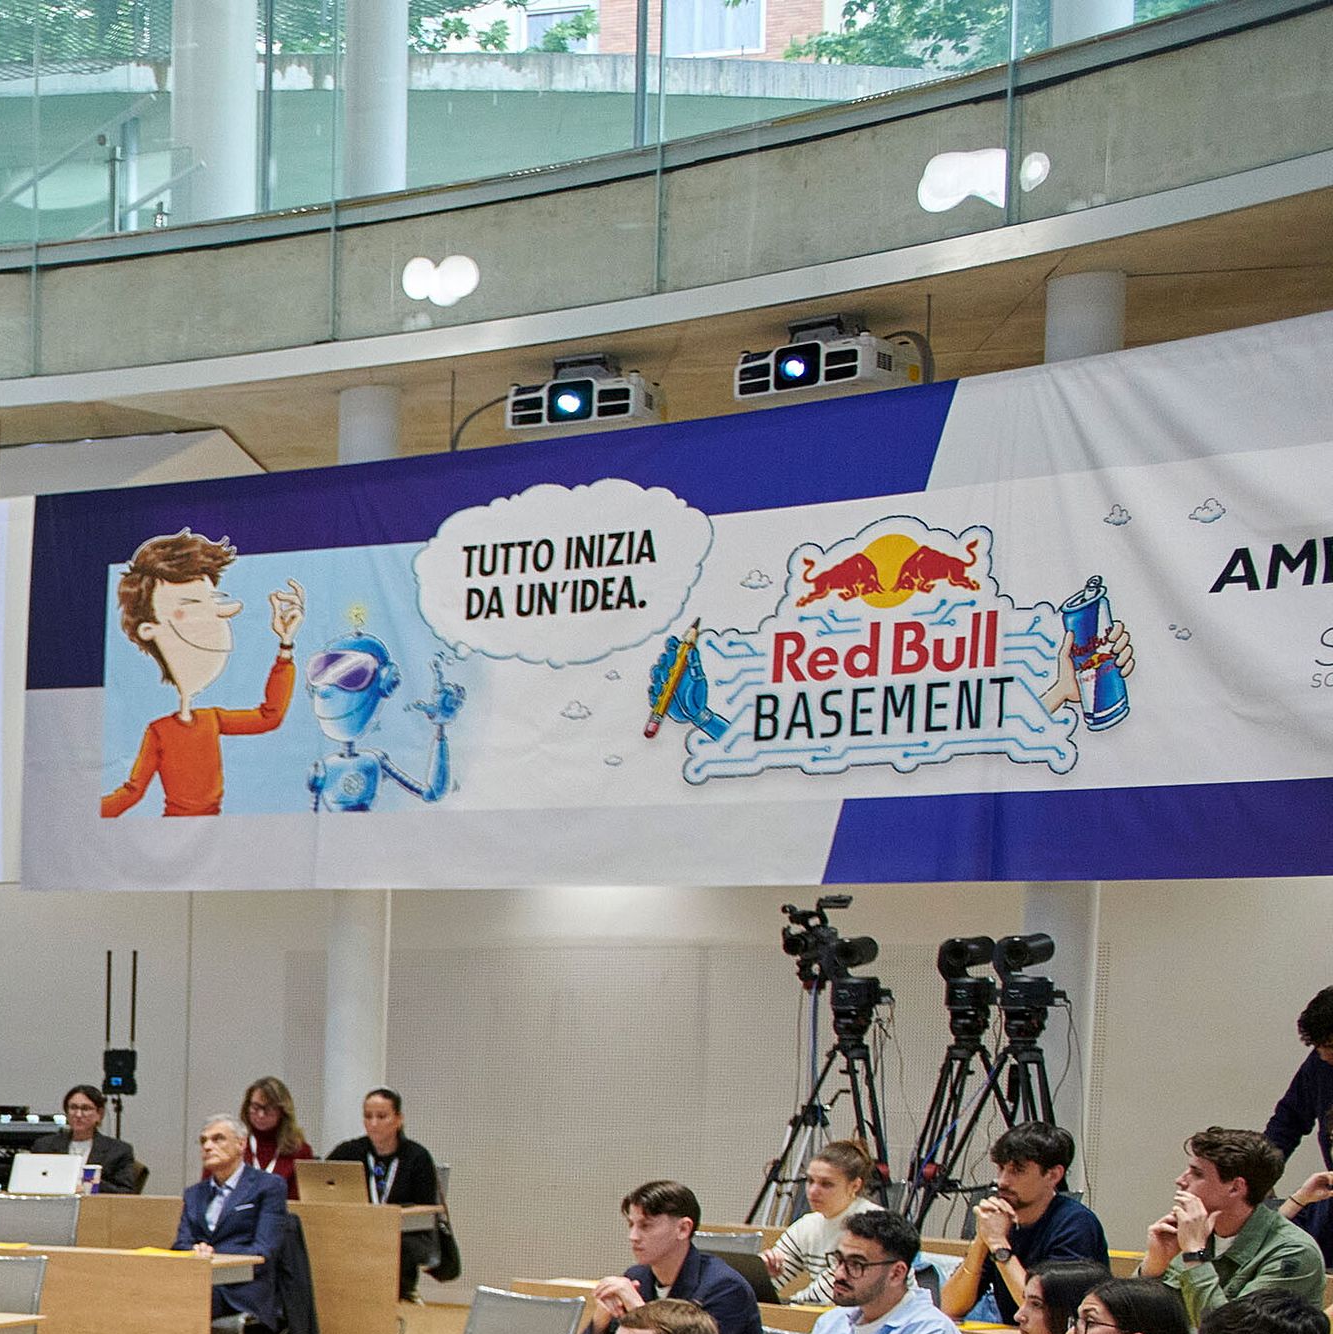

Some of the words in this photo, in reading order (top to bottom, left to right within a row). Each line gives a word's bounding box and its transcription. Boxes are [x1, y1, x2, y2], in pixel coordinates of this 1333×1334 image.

[462, 538, 554, 577] TUTTO
[564, 529, 657, 567] INIZIA
[1209, 536, 1333, 594] AM
[466, 586, 505, 620] DA
[515, 579, 647, 617] UN'IDEA.
[771, 622, 879, 684] Red
[892, 610, 998, 673] Bull
[753, 676, 1014, 741] BASEMENT
